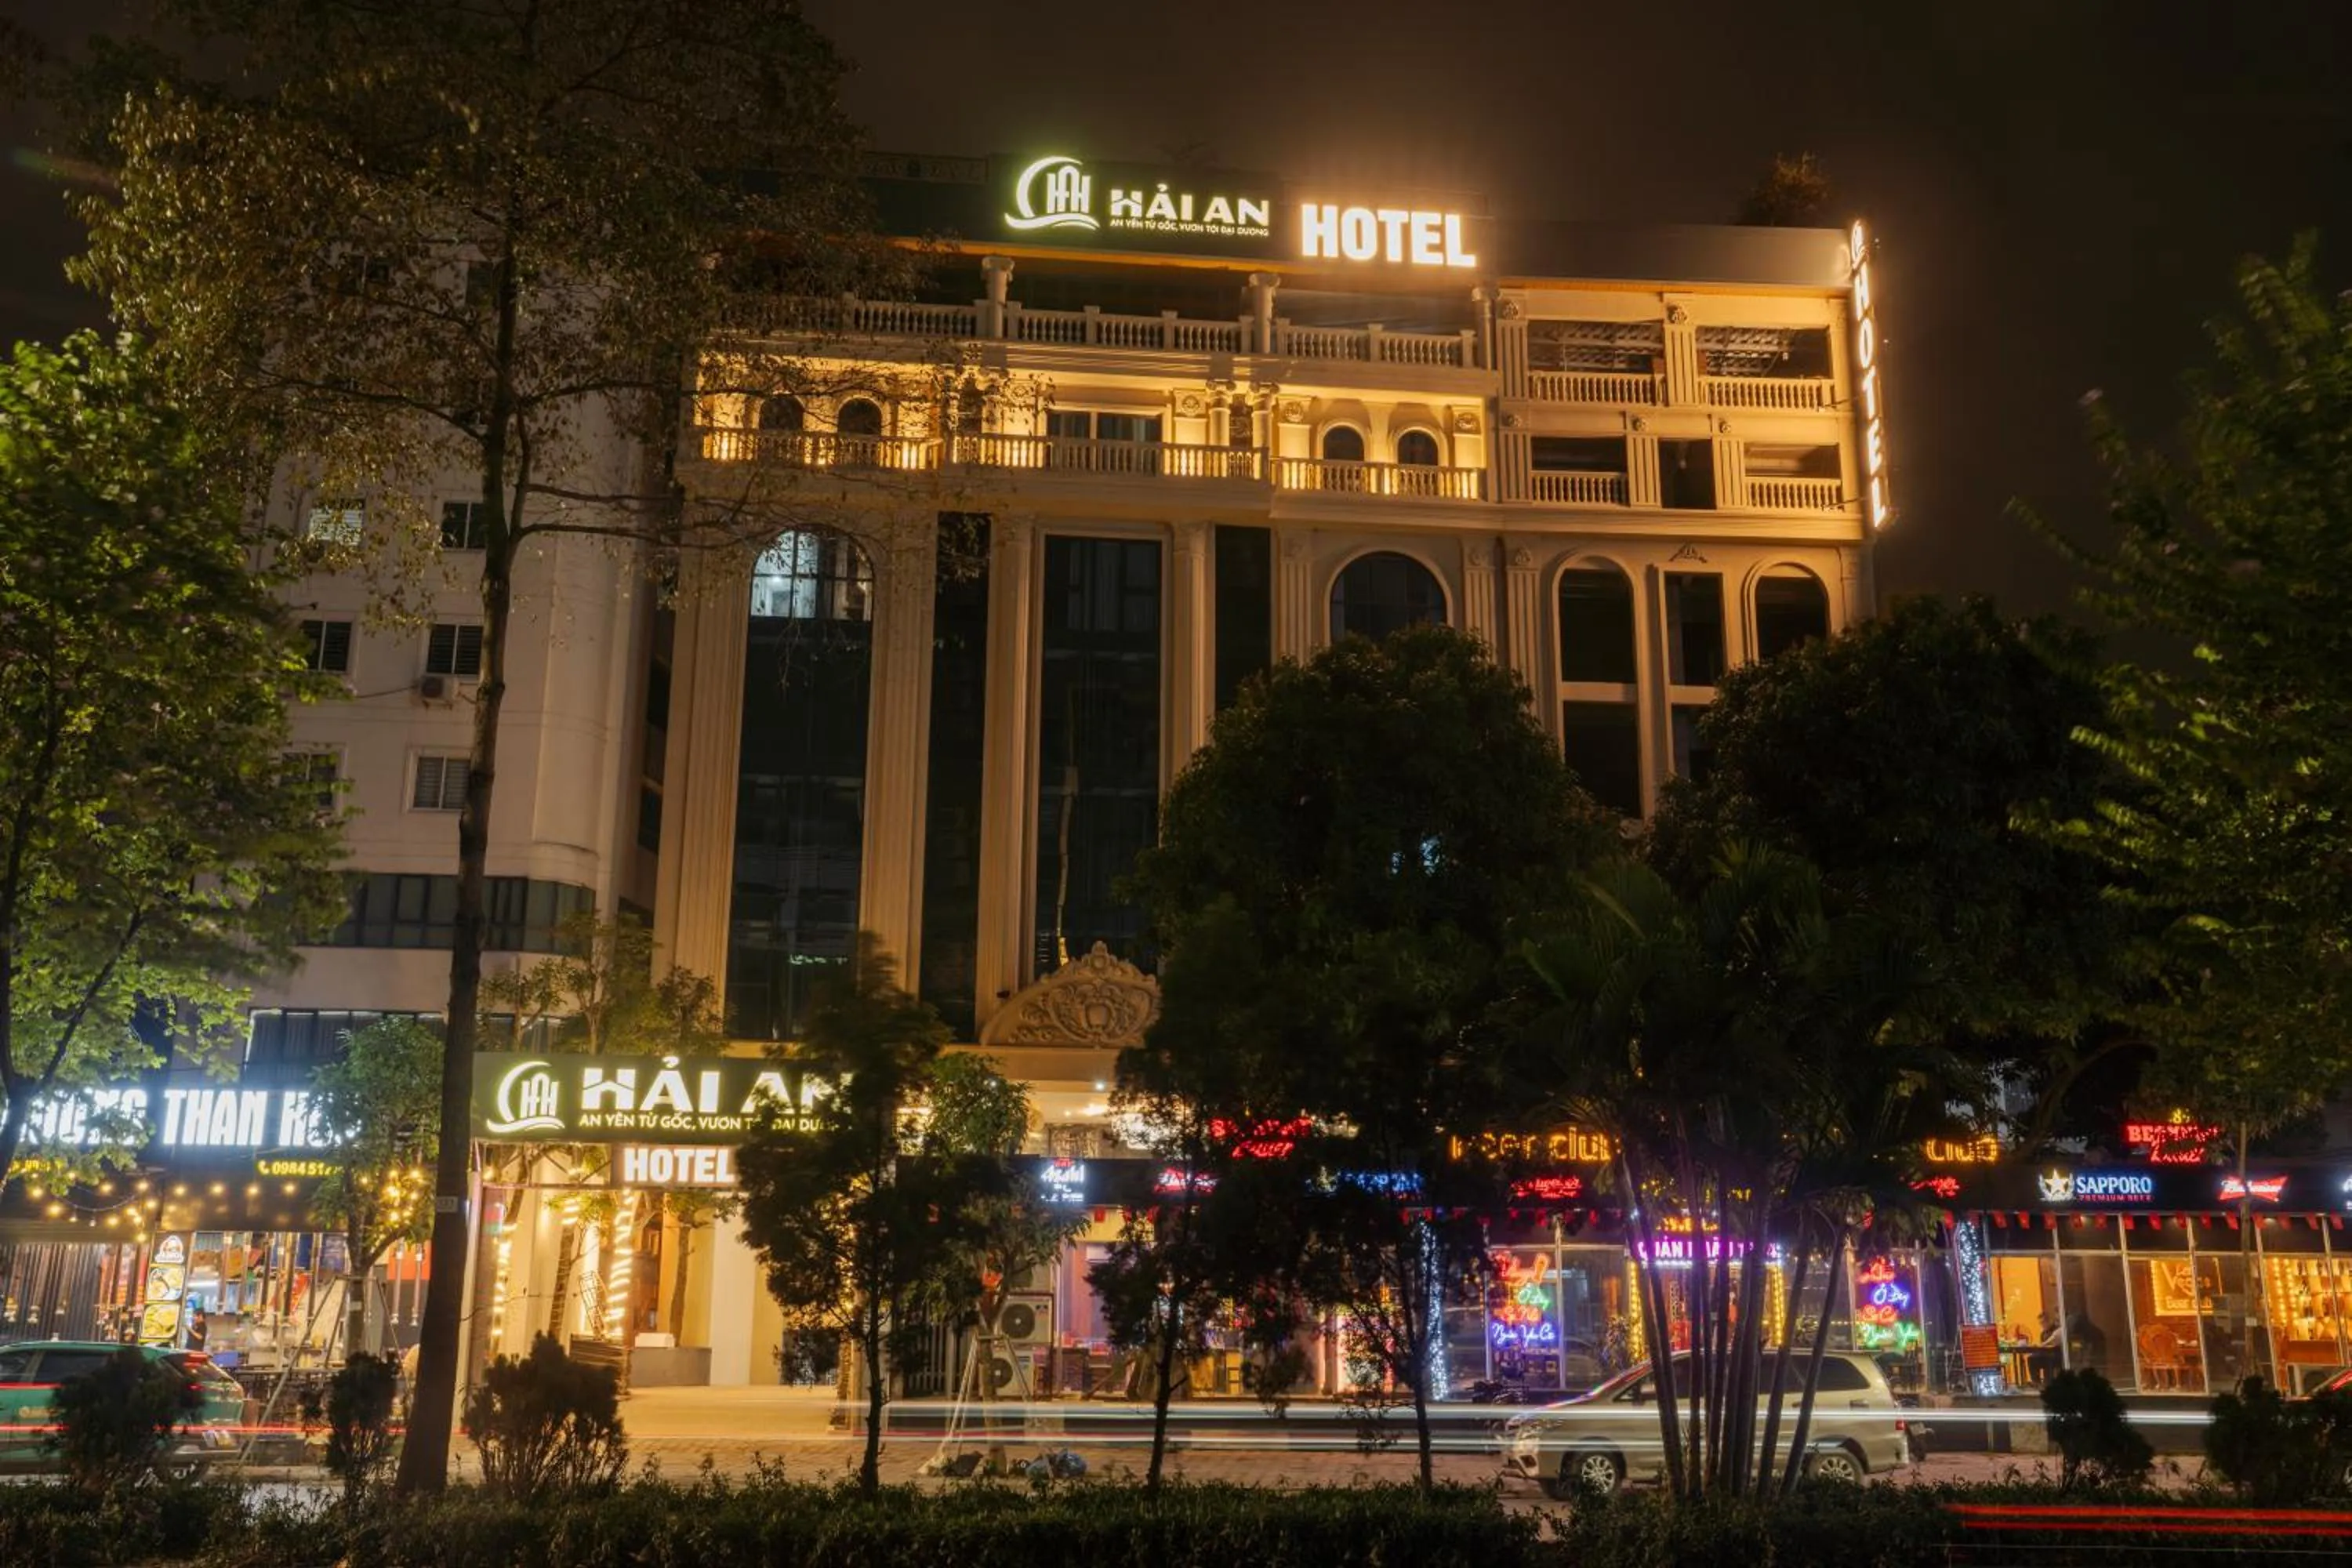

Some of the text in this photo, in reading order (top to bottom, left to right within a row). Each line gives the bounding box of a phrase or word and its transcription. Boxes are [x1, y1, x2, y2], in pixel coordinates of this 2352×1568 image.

[1110, 183, 1269, 227] HẢI AN
[1301, 203, 1478, 267] HOTEL
[1853, 261, 1886, 527] HOTEL
[581, 1055, 720, 1113] HẢI
[162, 1090, 268, 1145] THAN
[579, 1114, 601, 1127] AN
[605, 1112, 634, 1127] YÊN
[660, 1112, 696, 1130] GỐC,
[624, 1148, 736, 1182] HOTEL
[2077, 1176, 2153, 1194] SAPPORO
